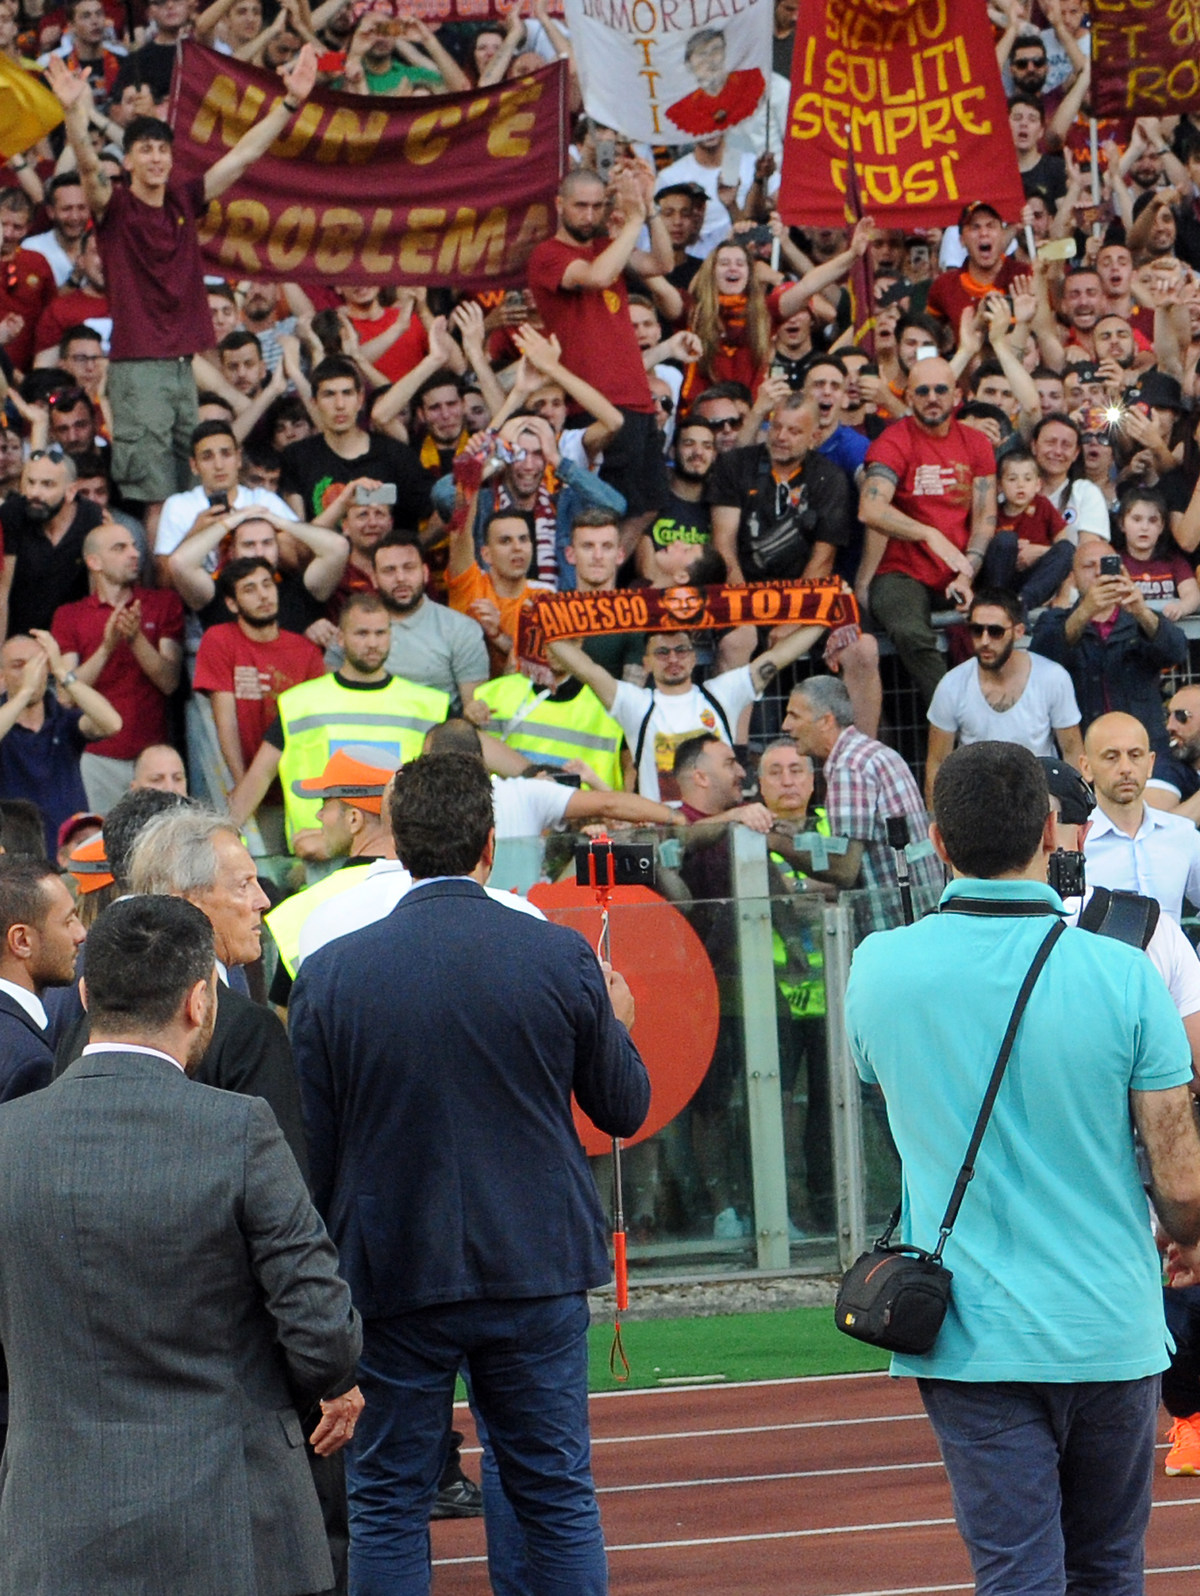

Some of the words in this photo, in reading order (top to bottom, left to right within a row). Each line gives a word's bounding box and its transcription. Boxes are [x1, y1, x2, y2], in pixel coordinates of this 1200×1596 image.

[803, 35, 817, 86] I
[822, 35, 972, 105] SOLITI
[791, 85, 992, 155] SEMPRE
